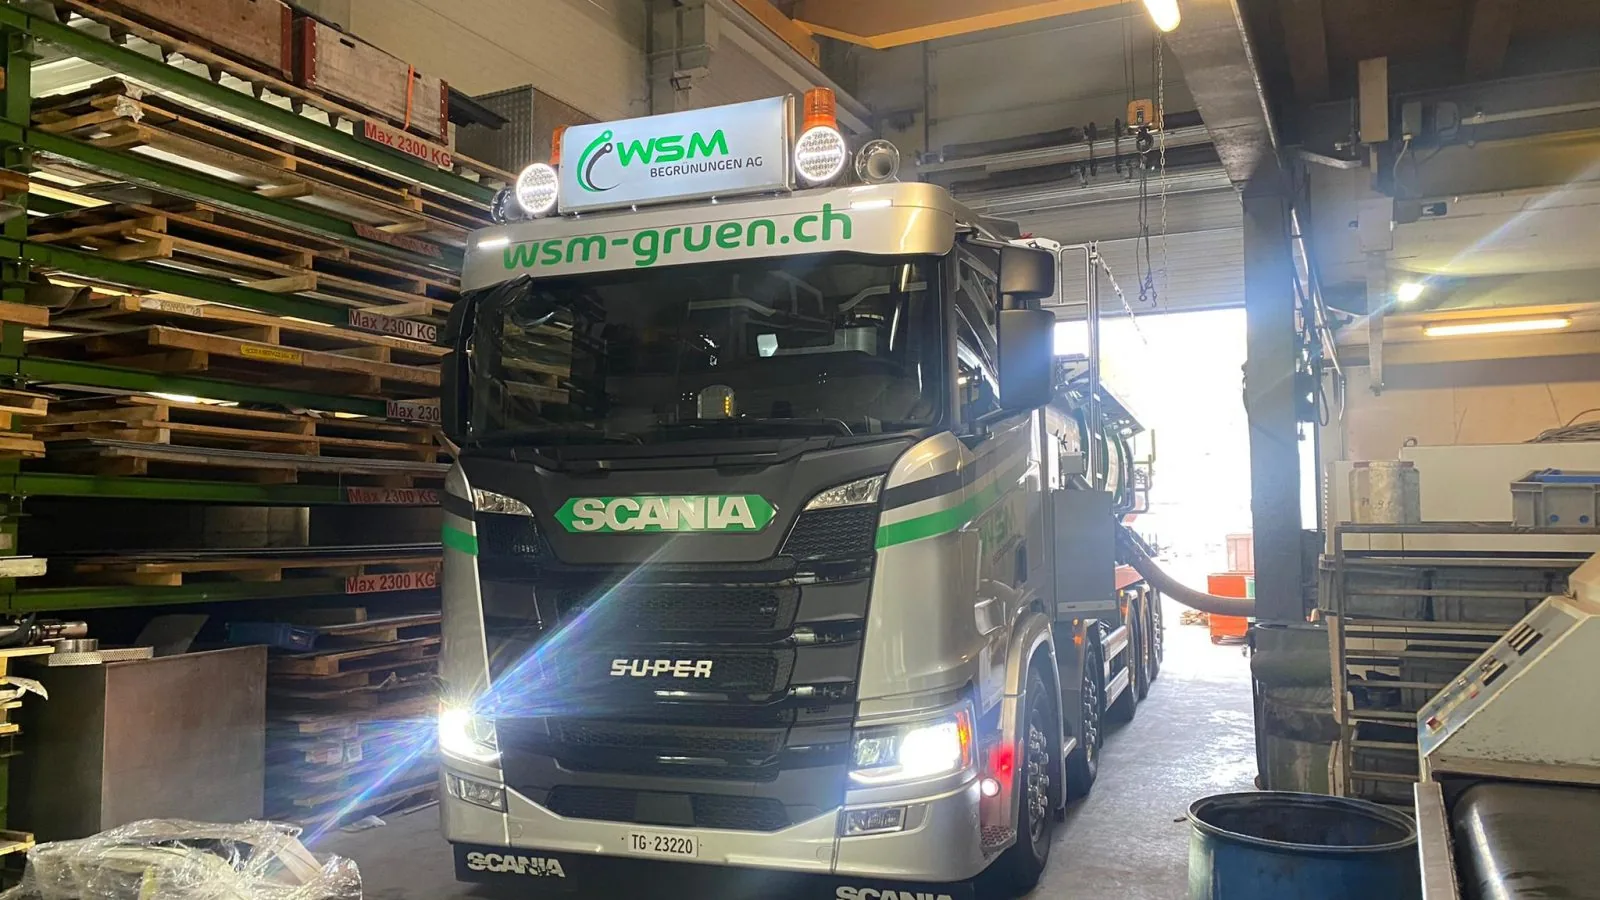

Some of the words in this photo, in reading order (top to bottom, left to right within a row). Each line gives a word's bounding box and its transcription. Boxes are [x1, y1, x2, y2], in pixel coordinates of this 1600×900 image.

[364, 122, 394, 146] Max
[398, 136, 427, 159] 2300
[432, 149, 451, 167] KG
[616, 129, 729, 167] WSM
[650, 157, 743, 178] BEGRÜNUNGEN
[745, 156, 763, 168] AG
[503, 203, 851, 270] wsm-gruen.ch
[350, 309, 377, 329] Max
[383, 318, 412, 335] 2300
[417, 324, 436, 340] KG
[387, 401, 414, 419] Max
[349, 489, 378, 502] Max
[384, 489, 414, 502] 2300
[419, 489, 437, 502] KG
[571, 496, 757, 532] SCANIA
[346, 577, 375, 593] Max
[379, 574, 411, 590] 2300
[415, 572, 435, 588] KG
[610, 659, 713, 678] SUPER
[467, 851, 565, 878] SCANIA
